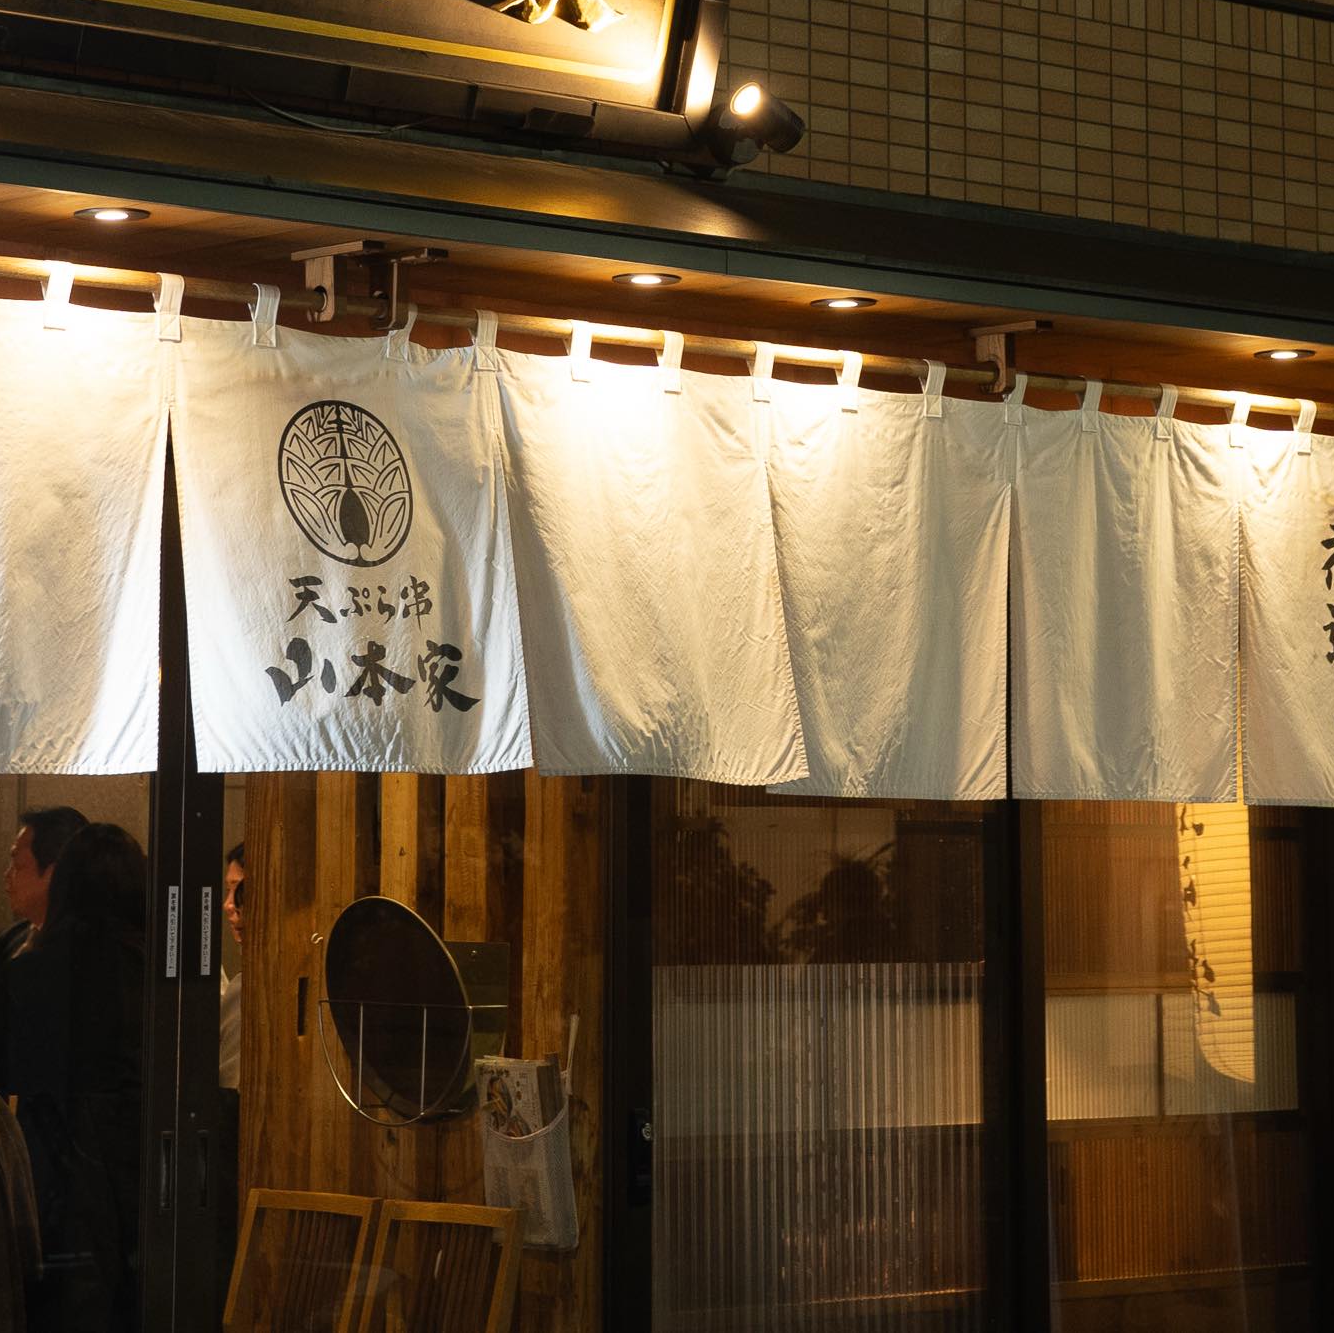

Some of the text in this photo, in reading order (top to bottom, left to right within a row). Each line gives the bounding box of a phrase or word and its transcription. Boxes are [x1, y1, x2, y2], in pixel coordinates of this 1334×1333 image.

[285, 574, 434, 630] 天ぷら串
[264, 637, 482, 713] 山本家
